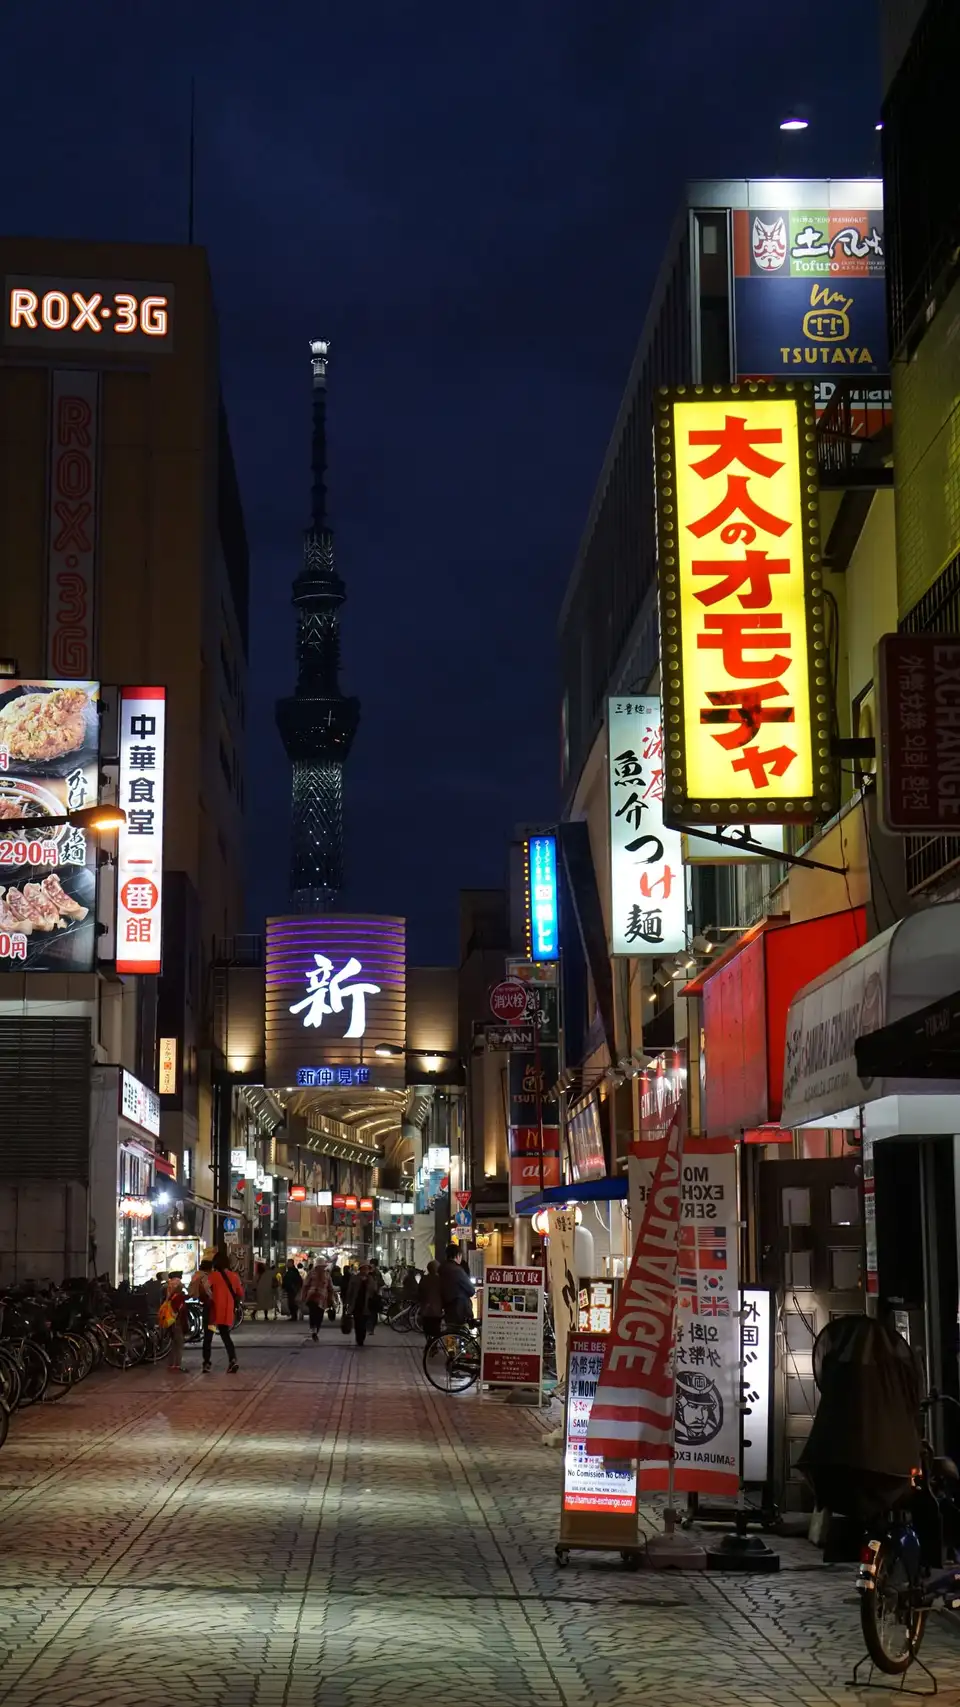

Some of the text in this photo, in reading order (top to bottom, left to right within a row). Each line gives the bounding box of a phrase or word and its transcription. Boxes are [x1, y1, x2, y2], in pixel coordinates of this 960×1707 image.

[793, 260, 840, 271] Tofuro
[780, 347, 874, 364] TSUTAYA
[687, 415, 798, 789] 大人のオモチャ
[933, 645, 960, 818] EXCHANGE
[614, 749, 676, 944] 魚介つけ麺
[288, 953, 381, 1038] 新
[494, 993, 524, 1009] 消火栓
[298, 1068, 370, 1087] 新仲見世
[522, 1164, 551, 1178] au
[489, 1270, 539, 1284] 高価買取
[573, 1341, 589, 1351] THE
[568, 1469, 634, 1481] No Comission No Charge
